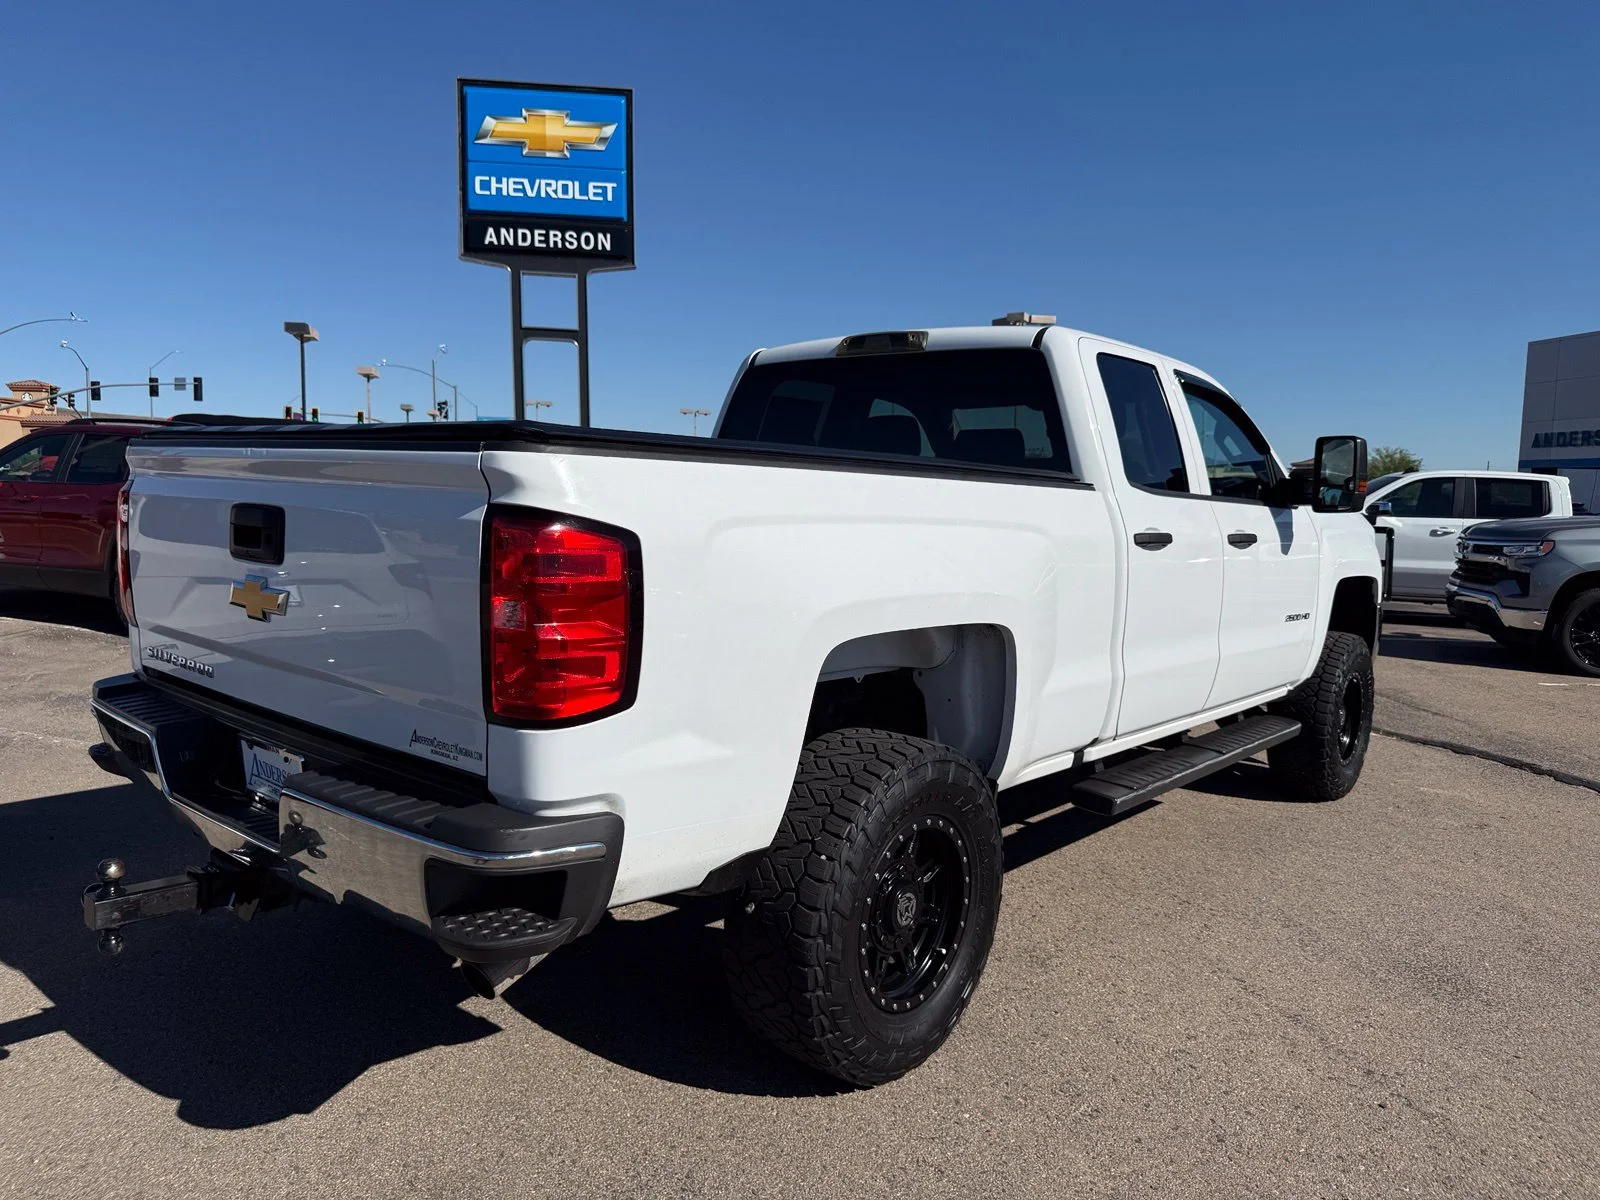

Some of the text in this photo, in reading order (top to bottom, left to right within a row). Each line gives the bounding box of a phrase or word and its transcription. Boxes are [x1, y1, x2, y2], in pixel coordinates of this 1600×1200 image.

[474, 175, 618, 202] CHEVROLET
[484, 226, 612, 251] ANDERSON
[1284, 612, 1311, 623] 2500 HD
[146, 645, 215, 678] SILVERADO
[247, 752, 292, 786] ANDERS
